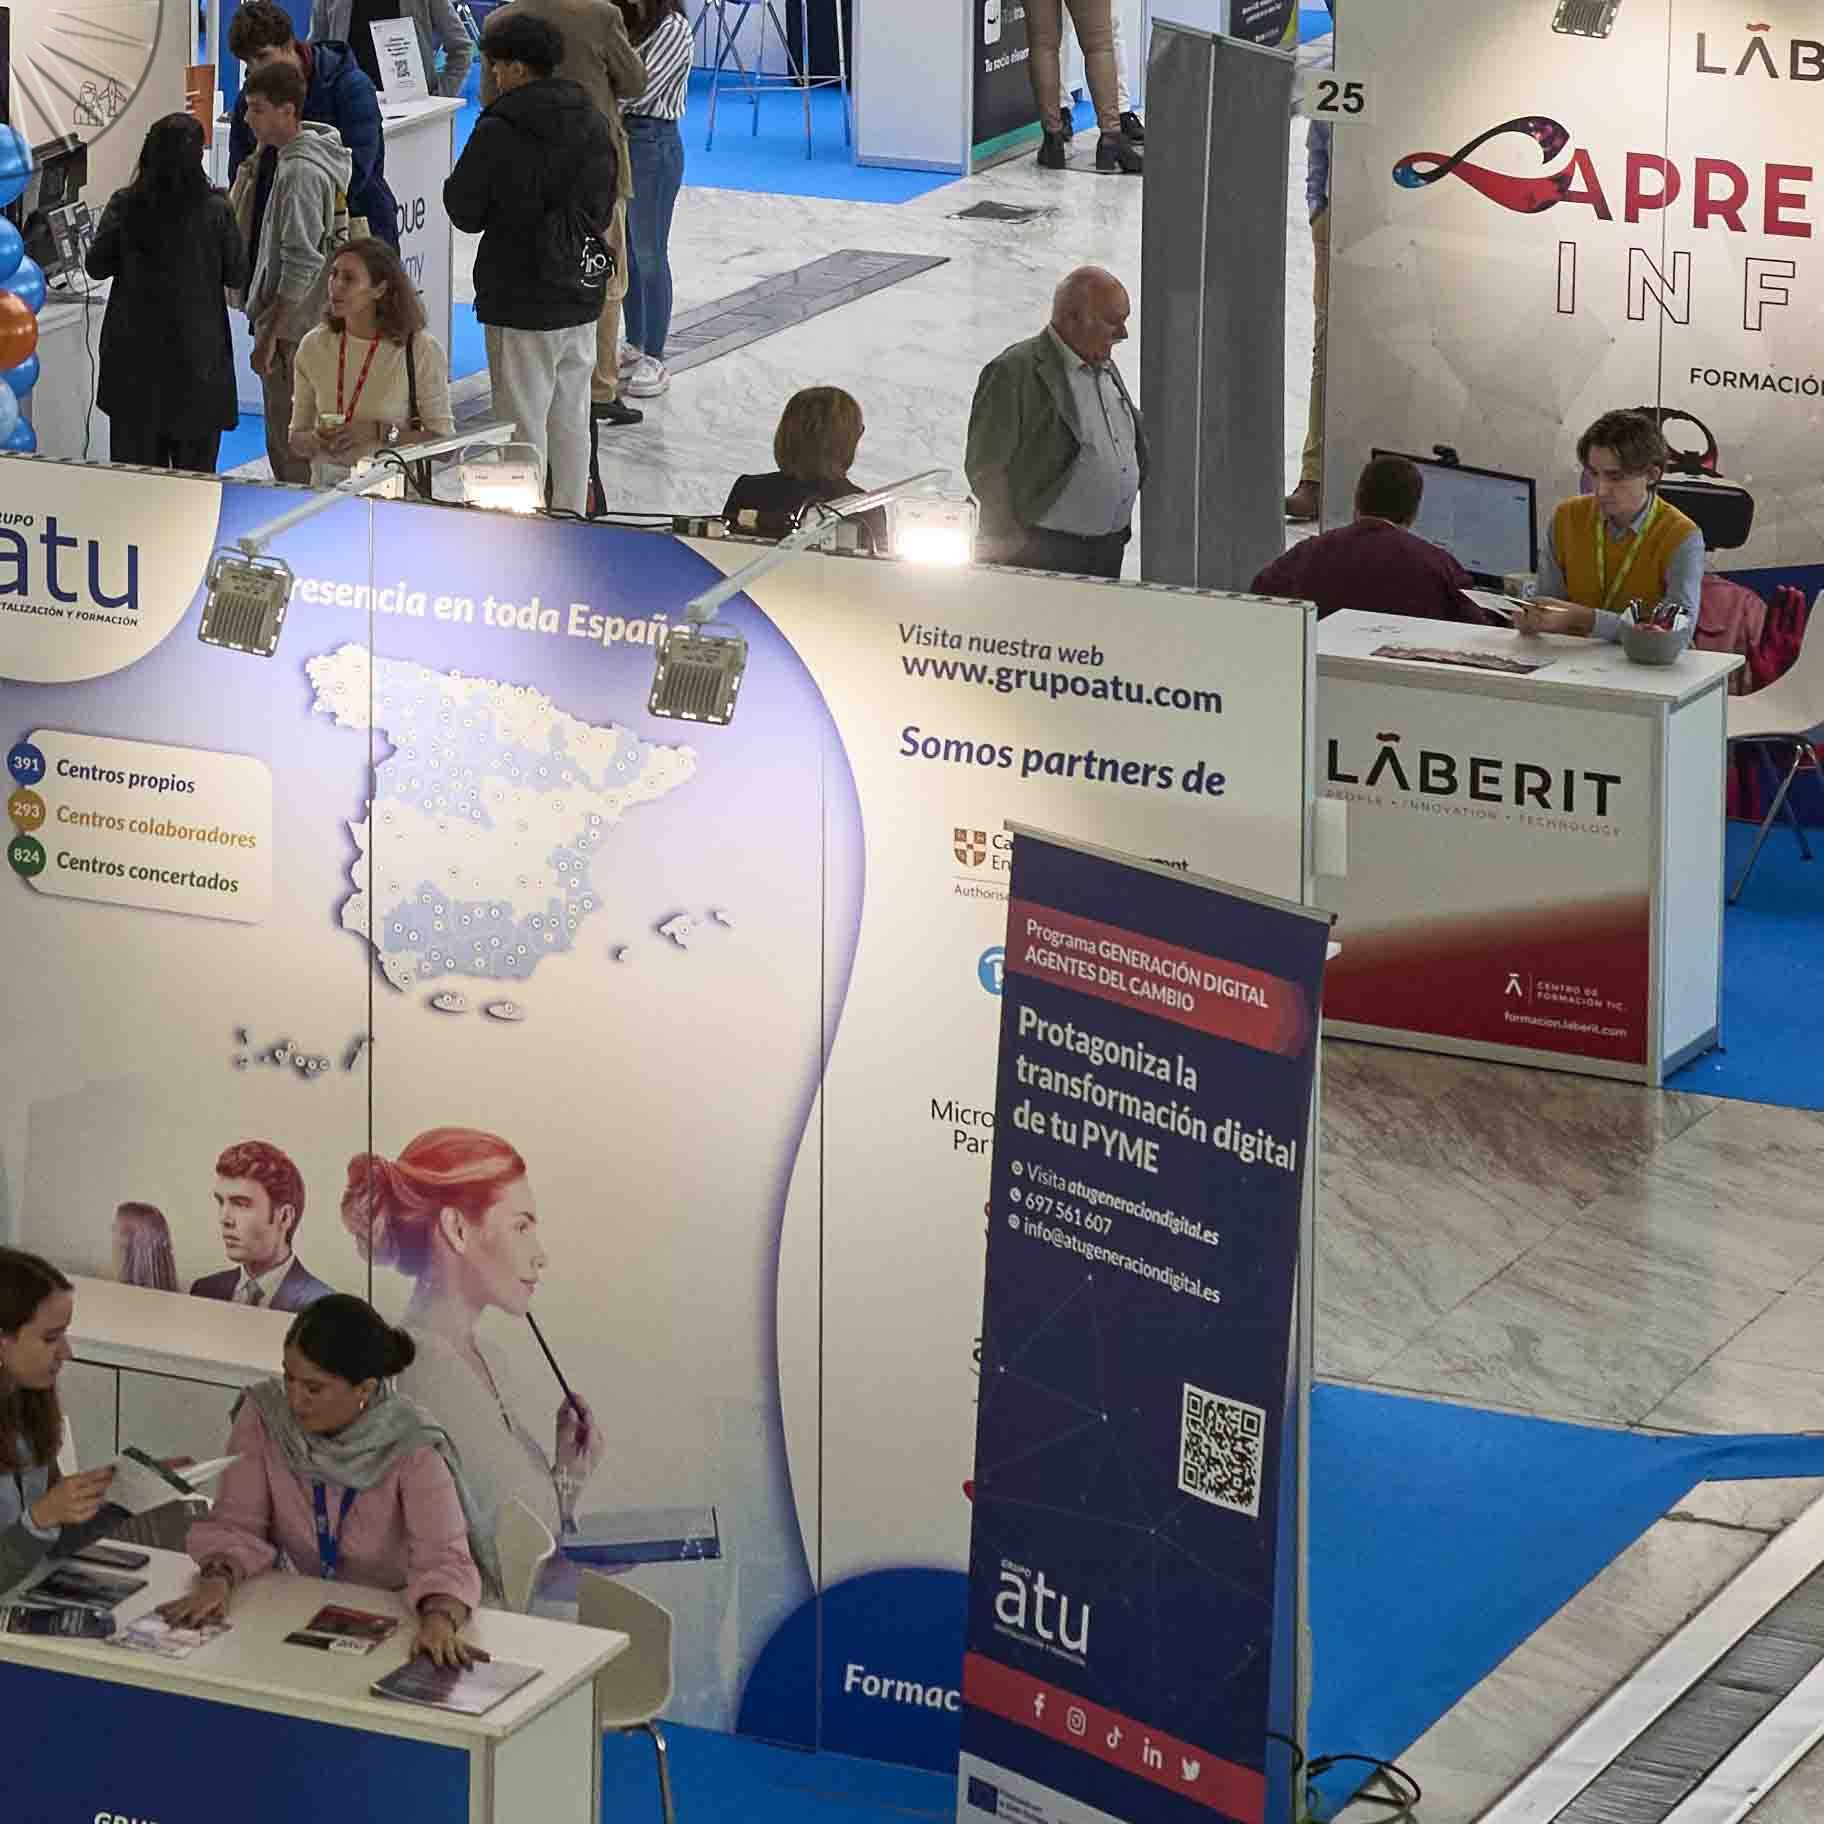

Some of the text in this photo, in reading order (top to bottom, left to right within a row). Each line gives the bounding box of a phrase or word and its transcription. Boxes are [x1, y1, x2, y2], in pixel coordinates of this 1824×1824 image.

[1316, 79, 1365, 114] 25
[1556, 240, 1797, 332] INF
[75, 610, 139, 627] FORMACIÓN
[290, 574, 427, 620] resencia
[433, 590, 475, 624] en
[480, 590, 560, 638] toda
[897, 622, 1105, 668] Visita nuestra web
[901, 653, 1224, 715] www.grupoatu.com
[13, 754, 196, 797] 391 Centros propios
[898, 725, 1227, 797] Somos partners de
[12, 801, 258, 852] 293 Centros colaboradores
[12, 847, 240, 896] 824 Centros concertados
[1024, 917, 1269, 1009] Programa GENERACIÓN DIGITAL
[1024, 945, 1196, 1012] AGENTES DEL CAMBIO
[1017, 1005, 1199, 1093] Protagoniza la
[1013, 1100, 1160, 1175] de tu PYME
[1015, 1052, 1297, 1174] transformación digital
[1024, 1192, 1113, 1236] 697 561 607
[1025, 1160, 1220, 1247] Visita atugeneraciondigital.es
[1023, 1216, 1222, 1306] info@atugeneraciondigital.es
[994, 1571, 1090, 1655] atu
